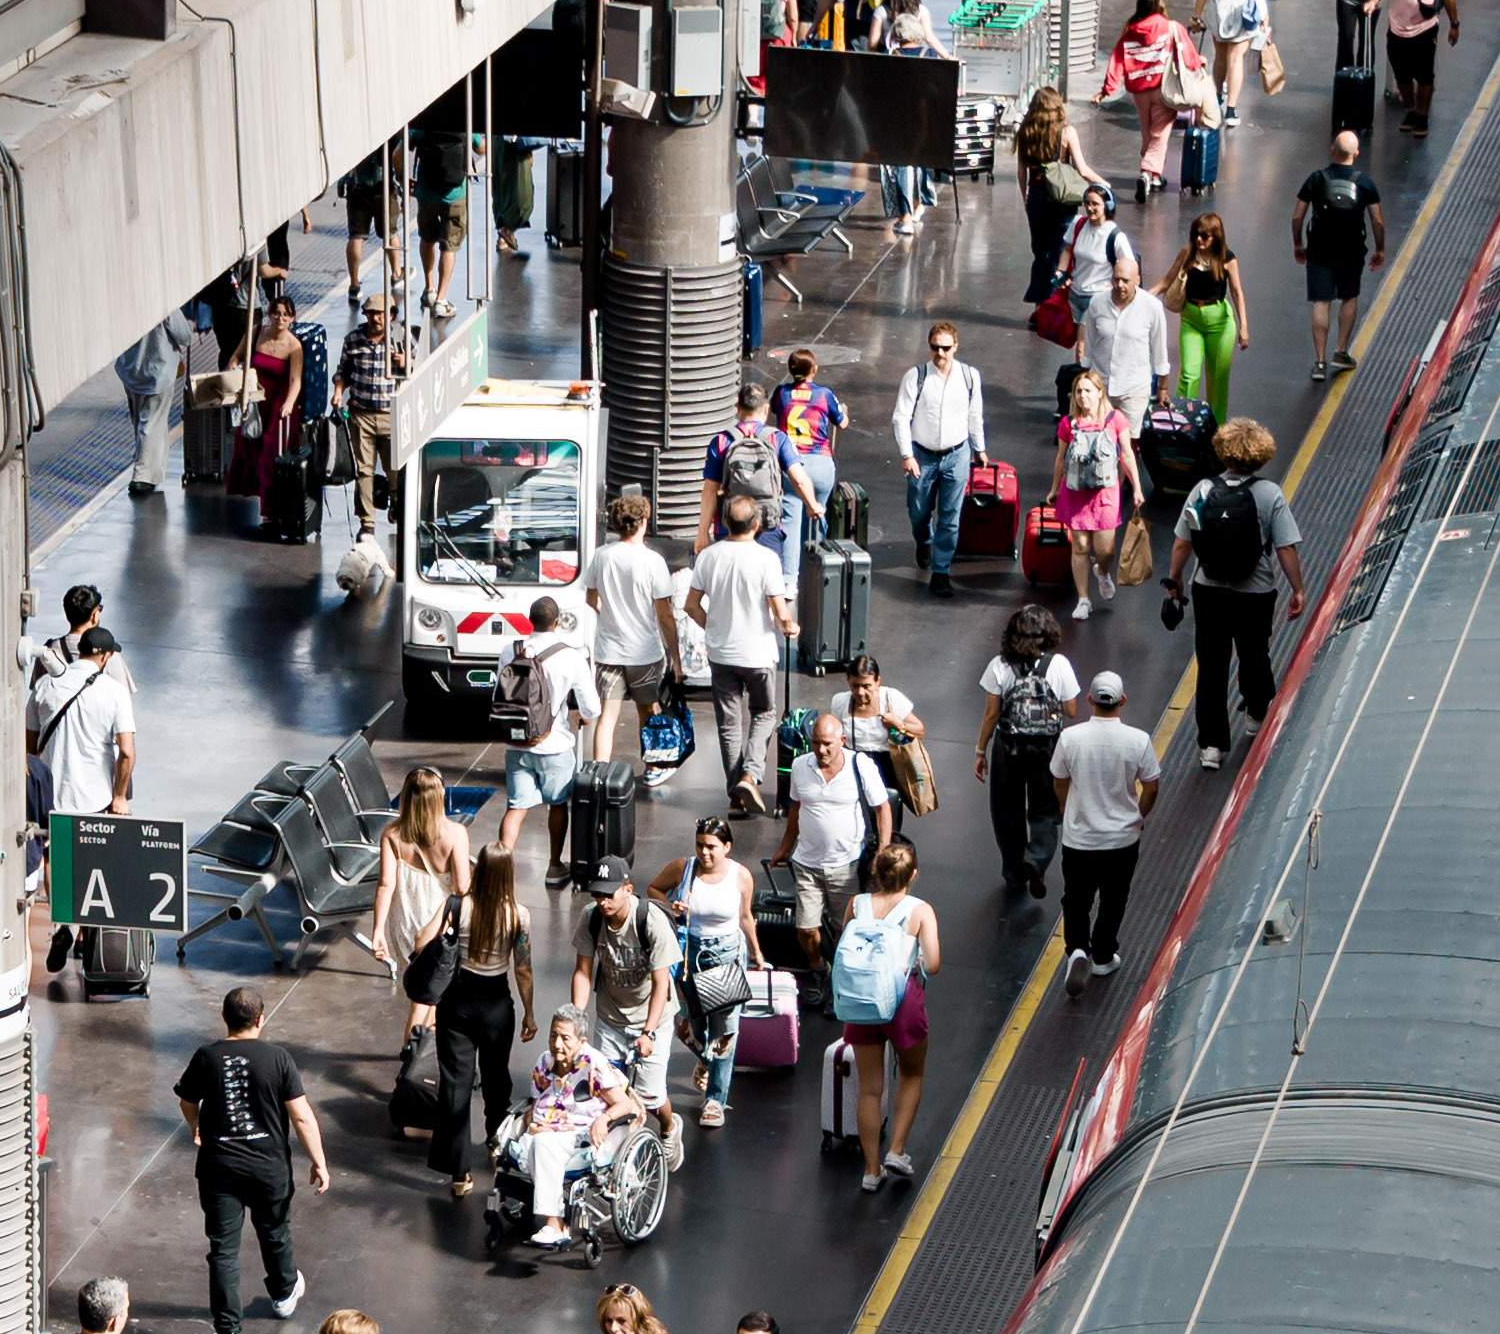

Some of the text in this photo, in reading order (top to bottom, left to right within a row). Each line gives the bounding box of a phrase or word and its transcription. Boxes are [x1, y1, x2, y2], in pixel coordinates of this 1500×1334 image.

[787, 404, 814, 446] 6
[79, 820, 160, 837] Sector Vía
[79, 836, 180, 850] SECTOR PLATFORM
[80, 868, 176, 923] A 2
